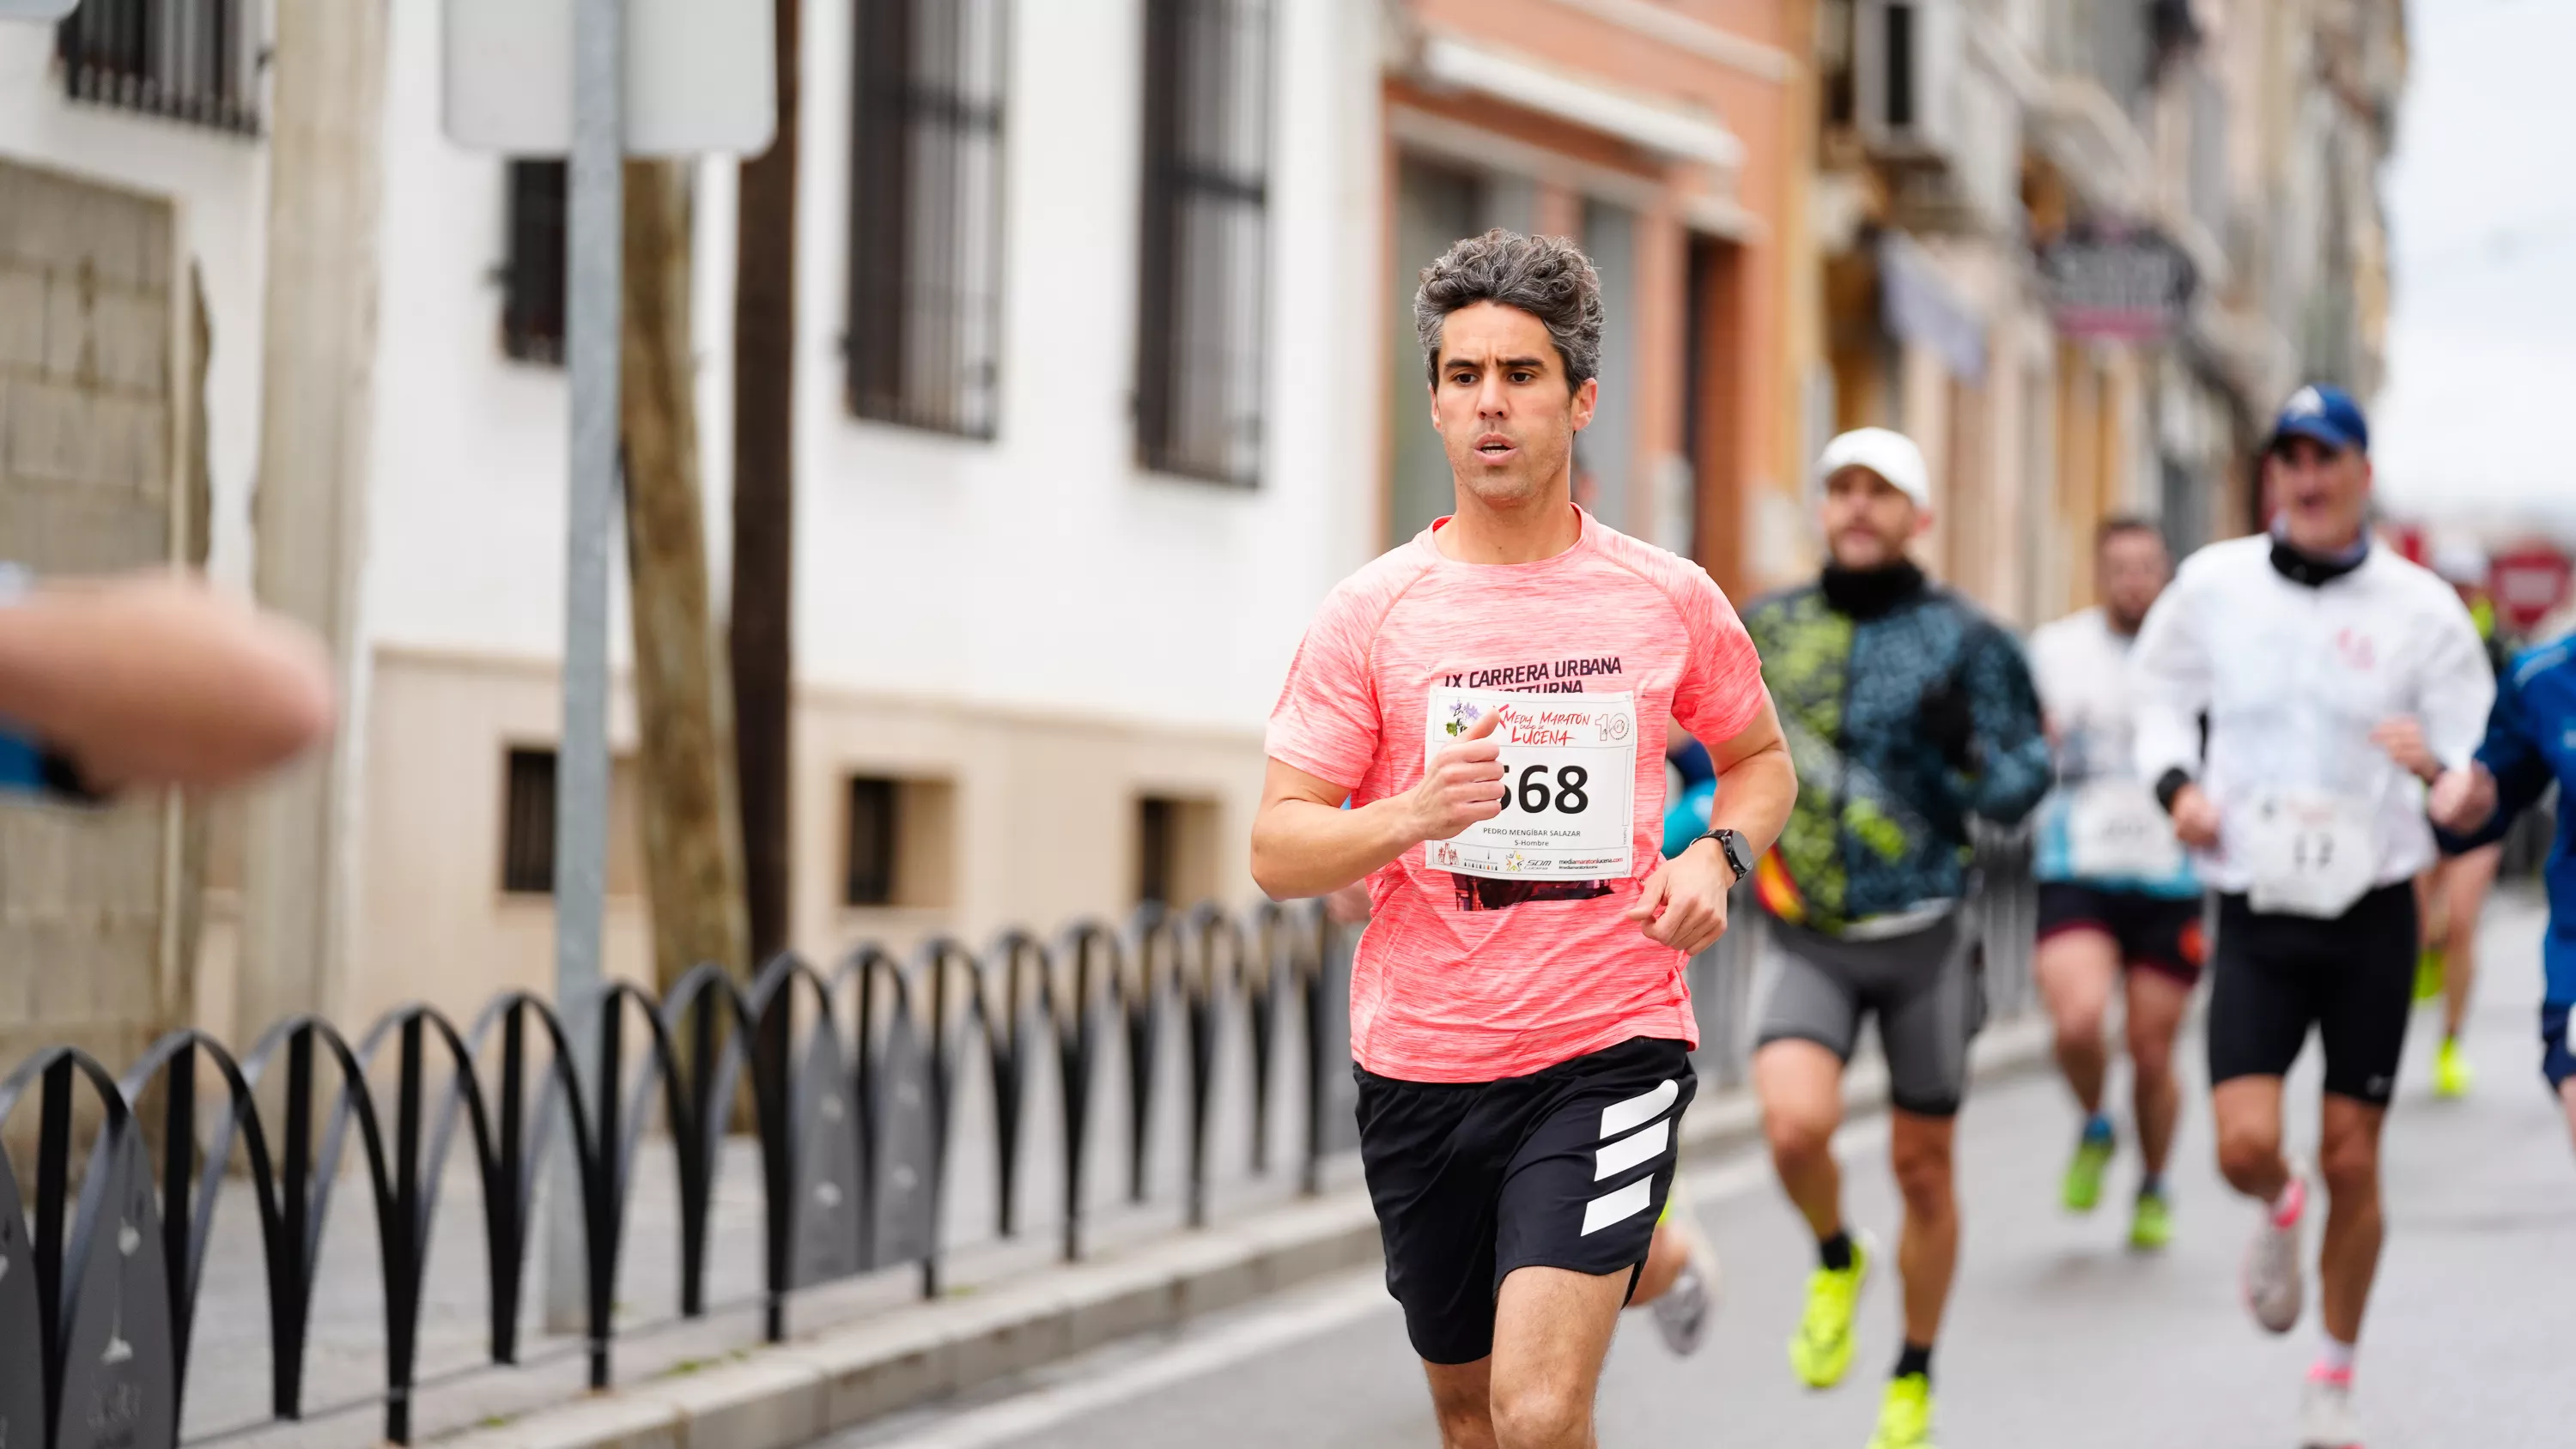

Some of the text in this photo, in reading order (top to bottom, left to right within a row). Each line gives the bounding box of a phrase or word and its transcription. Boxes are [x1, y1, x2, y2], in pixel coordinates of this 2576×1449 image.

[1445, 657, 1622, 688] IX CARRERA URBANA
[1511, 725, 1576, 746] LUCENA
